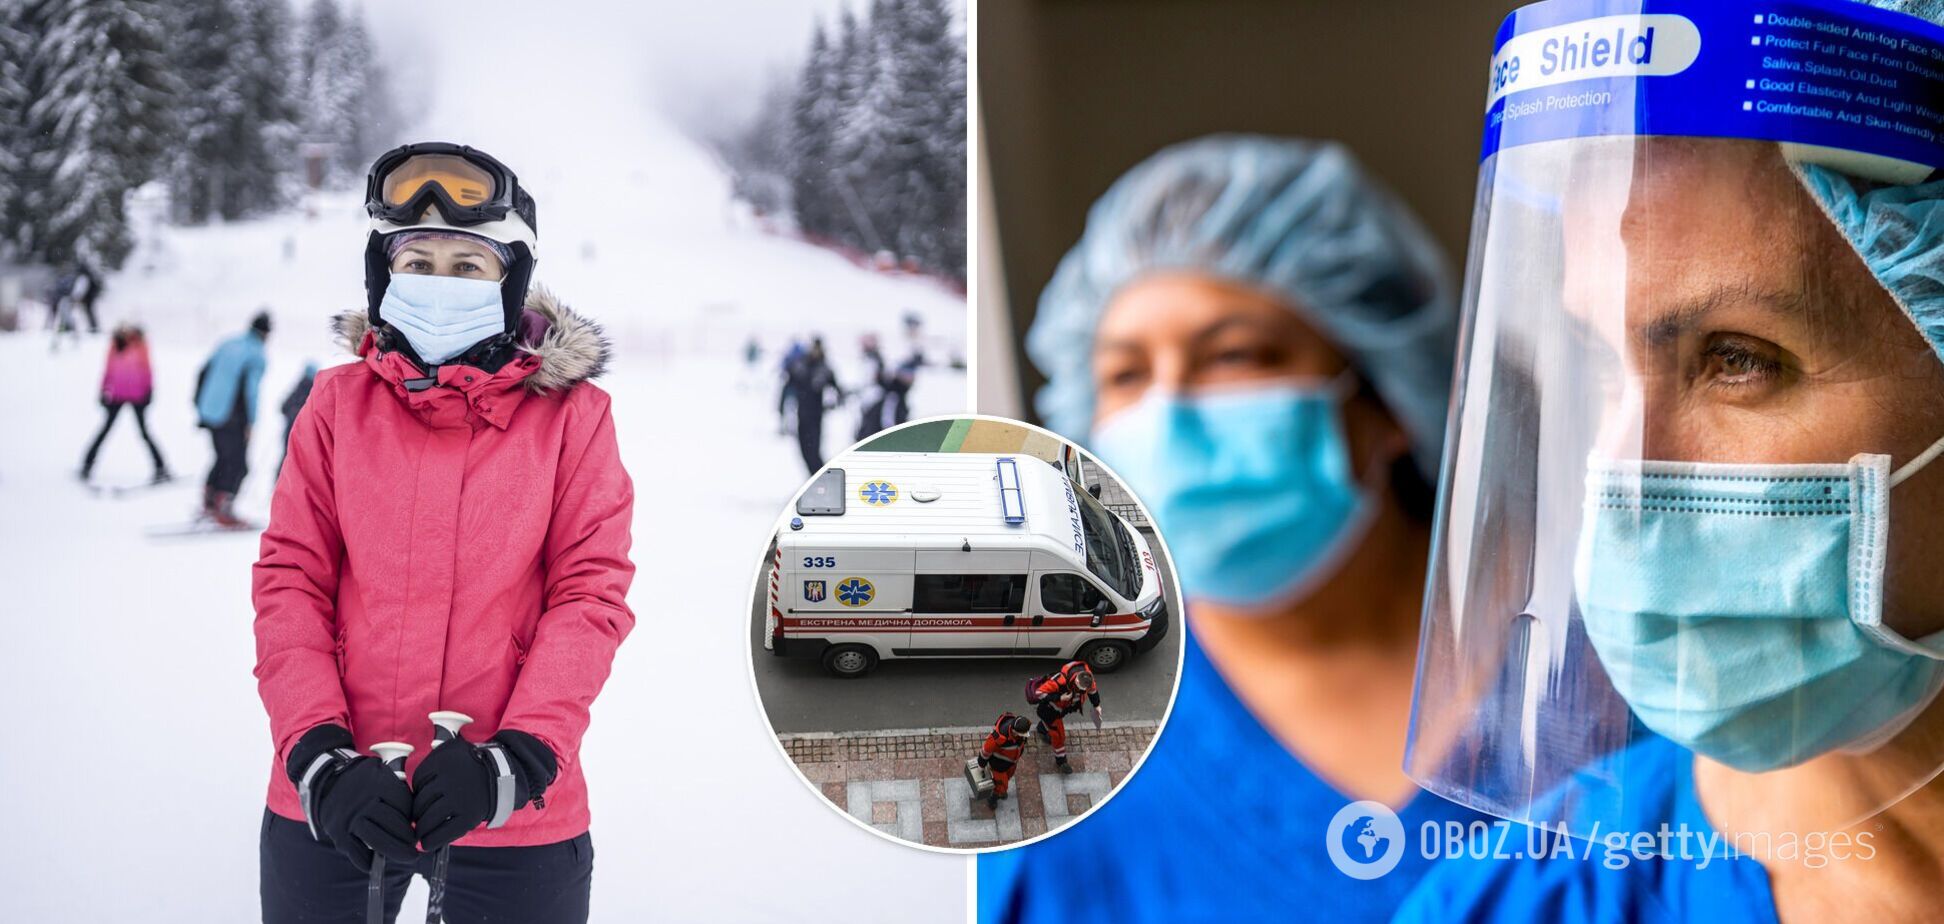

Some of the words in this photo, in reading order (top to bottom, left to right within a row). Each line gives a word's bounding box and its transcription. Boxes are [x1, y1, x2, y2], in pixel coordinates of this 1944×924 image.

[1540, 26, 1655, 76] Shield
[1765, 34, 1810, 50] Protect
[1813, 40, 1836, 54] Full
[1839, 46, 1869, 61] Face
[1871, 53, 1903, 69] From
[1767, 13, 1849, 37] Double-sided
[1852, 28, 1898, 50] Anti-fog
[1900, 38, 1928, 56] Face
[1508, 98, 1542, 121] Splash
[1546, 90, 1612, 112] Protection
[1759, 78, 1795, 92] Good
[1798, 81, 1852, 102] Elasticity
[1855, 92, 1881, 106] And
[1883, 97, 1912, 113] Light
[1757, 99, 1833, 119] Comfortable
[1836, 109, 1862, 124] And
[1865, 114, 1936, 142] Skin-friendly
[803, 556, 836, 568] 335
[1142, 551, 1155, 571] 103
[800, 618, 857, 626] ЕКСТРЕНА
[858, 618, 911, 626] МЕДИЧНА
[911, 618, 973, 627] ДОПОМОГА
